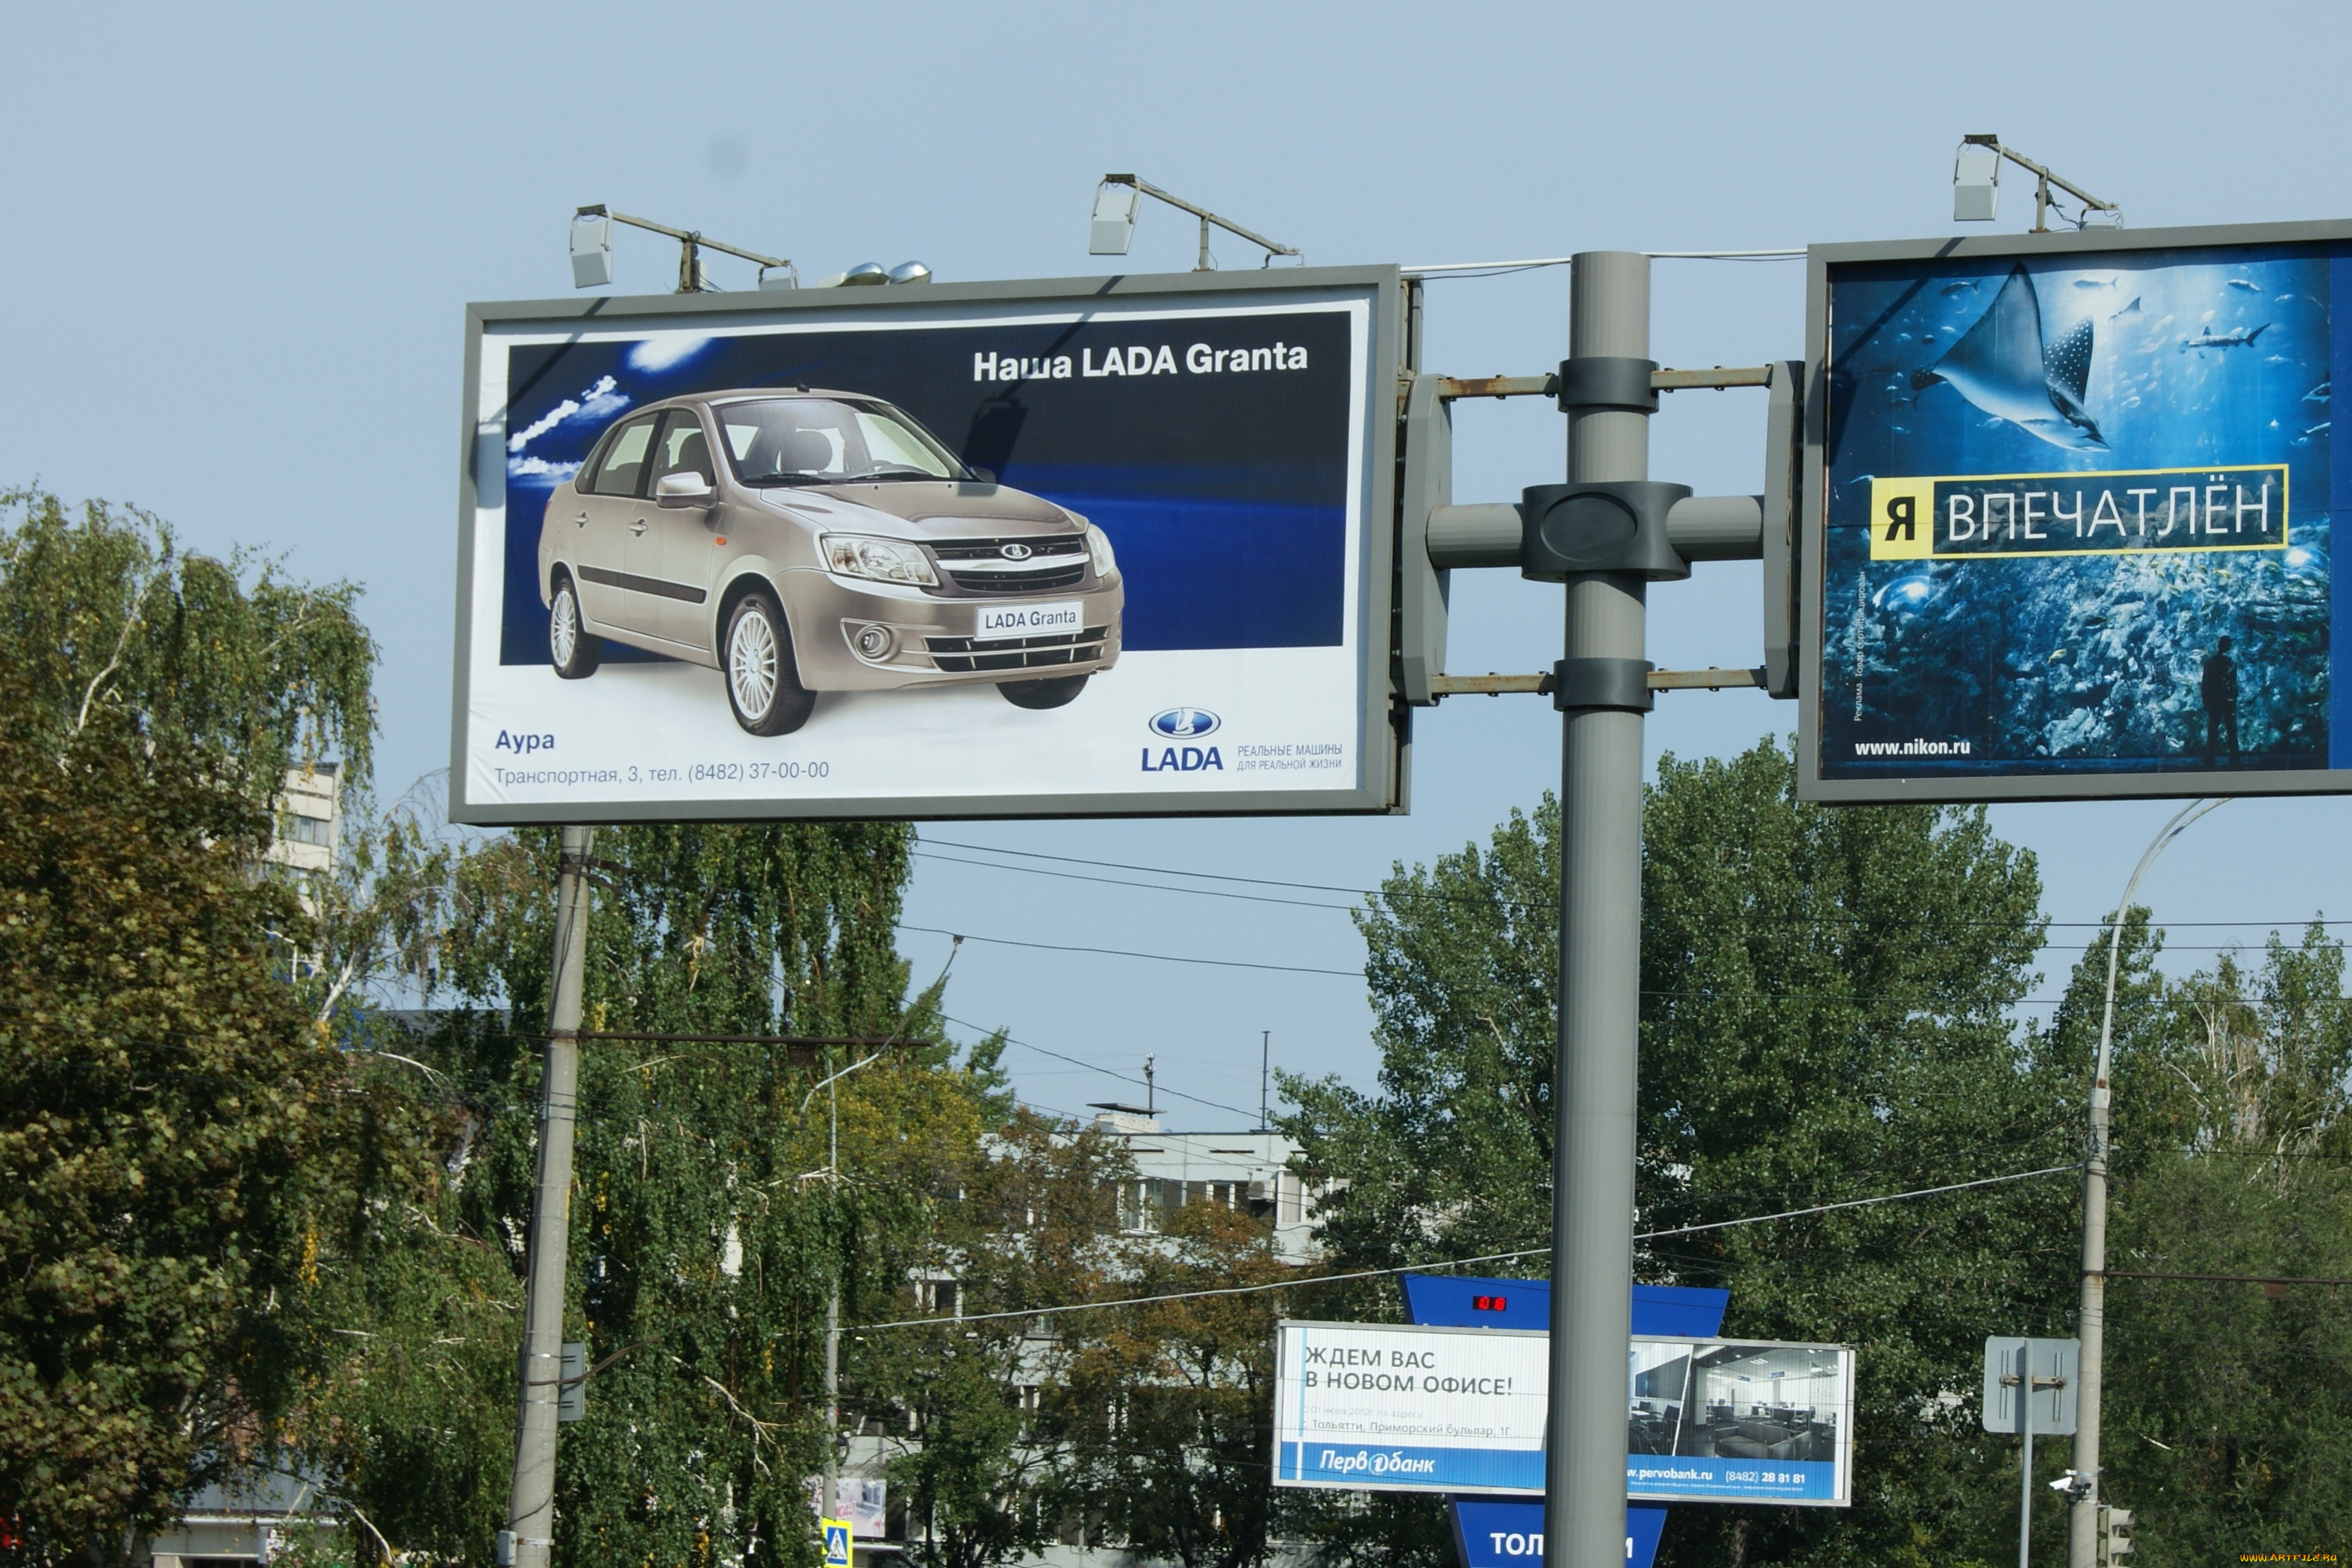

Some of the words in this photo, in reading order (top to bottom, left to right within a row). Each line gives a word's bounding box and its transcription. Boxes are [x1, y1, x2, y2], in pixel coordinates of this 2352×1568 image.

[974, 352, 1072, 382] Наша
[1083, 345, 1178, 377] LADA
[1186, 341, 1308, 374] Granta
[1884, 496, 1916, 542] Я
[1948, 474, 2269, 542] ВПЕЧАТЛЁН
[985, 612, 1026, 630] LADA
[1030, 609, 1076, 626] Granta
[1855, 650, 1866, 676] Товар
[494, 729, 556, 754] Аура
[1237, 744, 1292, 757] РЕАЛЬНЫЕ
[1296, 744, 1343, 756] МАШИНЫ
[1855, 737, 1971, 757] www.nikon.ru
[1142, 747, 1224, 771] LADA
[1237, 760, 1256, 772] ДЛЯ
[1259, 758, 1306, 770] РЕАЛЬНОЙ
[1309, 759, 1343, 769] ЖИЗНИ
[494, 767, 623, 786] Транспортная,
[628, 766, 643, 784] 3,
[648, 768, 682, 783] тел.
[688, 762, 744, 784] (8482)
[749, 761, 830, 780] 37-00-00
[1305, 1346, 1381, 1369] ЖДЕМ
[1391, 1350, 1435, 1369] ВАС
[1305, 1371, 1318, 1387] В
[1327, 1372, 1414, 1393] НОВОМ
[1423, 1376, 1512, 1396] ОФИСЕ!
[1370, 1422, 1443, 1435] Приморский
[1726, 1471, 1758, 1484] (8482)
[1761, 1472, 1776, 1482] 28
[1778, 1473, 1790, 1484] 81
[1793, 1473, 1805, 1484] 81
